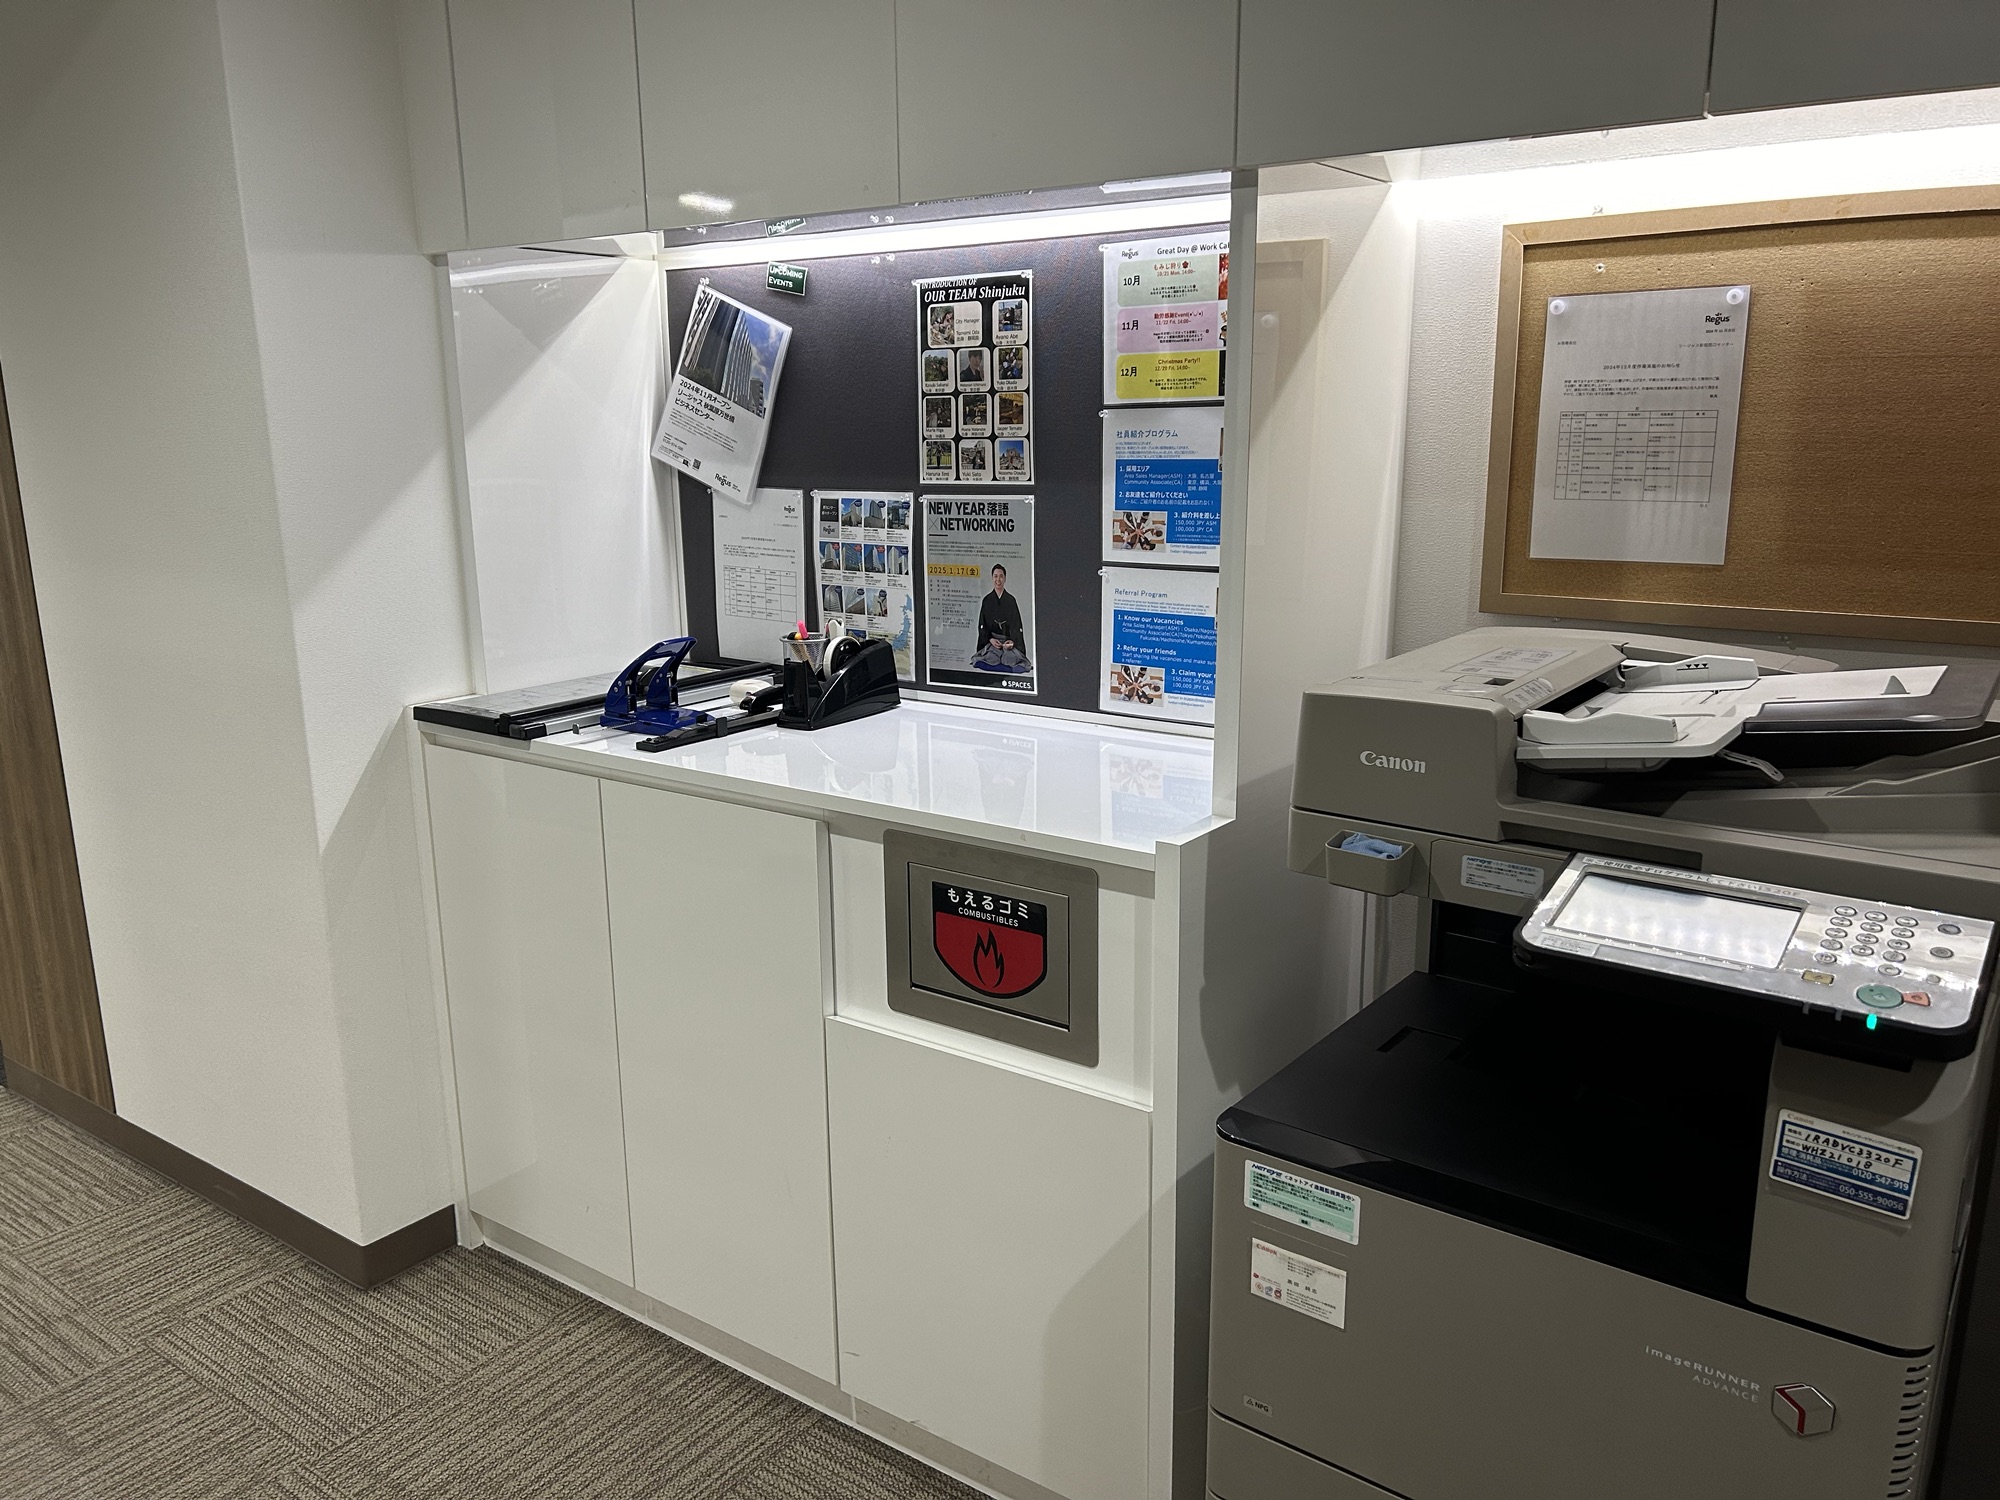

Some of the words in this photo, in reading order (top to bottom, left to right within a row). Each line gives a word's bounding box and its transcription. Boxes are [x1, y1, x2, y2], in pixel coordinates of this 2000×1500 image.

[1122, 248, 1139, 259] Regus
[1157, 247, 1175, 255] Great
[1177, 246, 1190, 255] Day
[1191, 245, 1198, 253] @
[769, 266, 803, 279] UPCOMING
[769, 277, 793, 288] EVENTS
[921, 280, 967, 289] INTRODUCTION
[1123, 275, 1141, 286] 10月
[924, 290, 946, 302] OUR
[948, 288, 977, 300] TEAM
[979, 284, 1026, 299] Shinjuku
[1704, 312, 1732, 325] Regus
[1122, 320, 1139, 331] 11月
[1120, 366, 1137, 377] 12月
[677, 388, 703, 407] リージャス
[680, 379, 732, 410] 2024年11月オープン
[675, 397, 715, 421] ビジネスセンター
[1116, 430, 1178, 439] 社員紹介プログラム
[715, 473, 732, 487] Regus
[929, 502, 952, 515] NEW
[955, 502, 986, 516] YEAR
[986, 502, 1009, 517] 落語
[939, 517, 1015, 533] NETWORKING
[929, 566, 979, 576] 2025.1.17(金)
[1115, 588, 1139, 596] Referral
[1140, 590, 1168, 598] Program
[1153, 617, 1184, 625] Vacancies
[1140, 646, 1154, 654] your
[1154, 647, 1177, 655] friends
[1178, 669, 1197, 677] Claim
[1359, 750, 1427, 774] Canon
[947, 887, 1029, 919] もえるゴミ
[958, 907, 1019, 927] COMBUSTIBLES
[1787, 1113, 1814, 1125] Canon
[1852, 1168, 1909, 1191] 0120-547-919
[1839, 1185, 1904, 1211] 050-555-90056
[1256, 1243, 1278, 1256] Canon
[1645, 1345, 1760, 1392] imageRUNNER
[1692, 1374, 1759, 1403] ADVANCE
[1254, 1401, 1269, 1413] NPG
